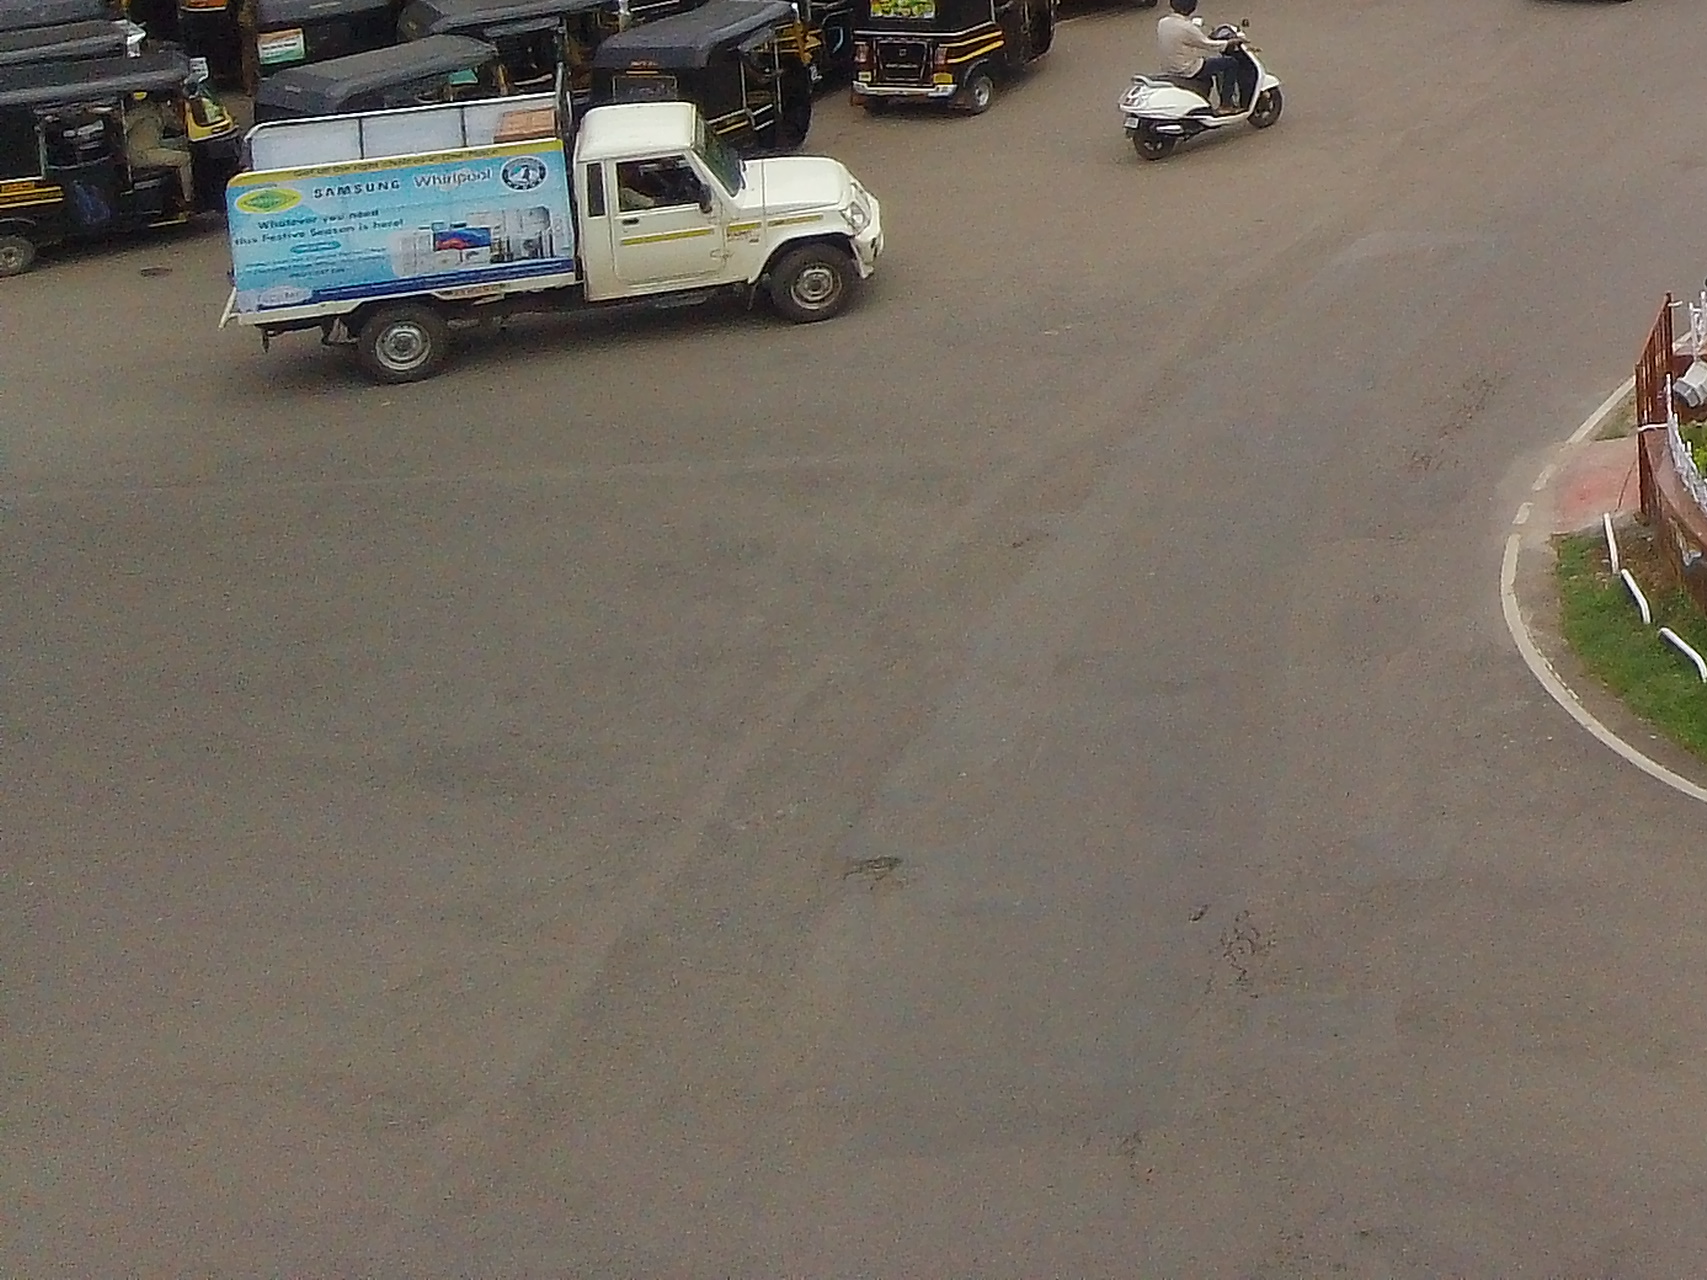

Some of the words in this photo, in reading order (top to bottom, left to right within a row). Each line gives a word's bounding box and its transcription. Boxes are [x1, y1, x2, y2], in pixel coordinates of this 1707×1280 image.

[413, 167, 493, 189] Whirlpool
[313, 178, 401, 200] SAMSUNG
[258, 216, 317, 230] Whatever
[310, 224, 355, 238] Season
